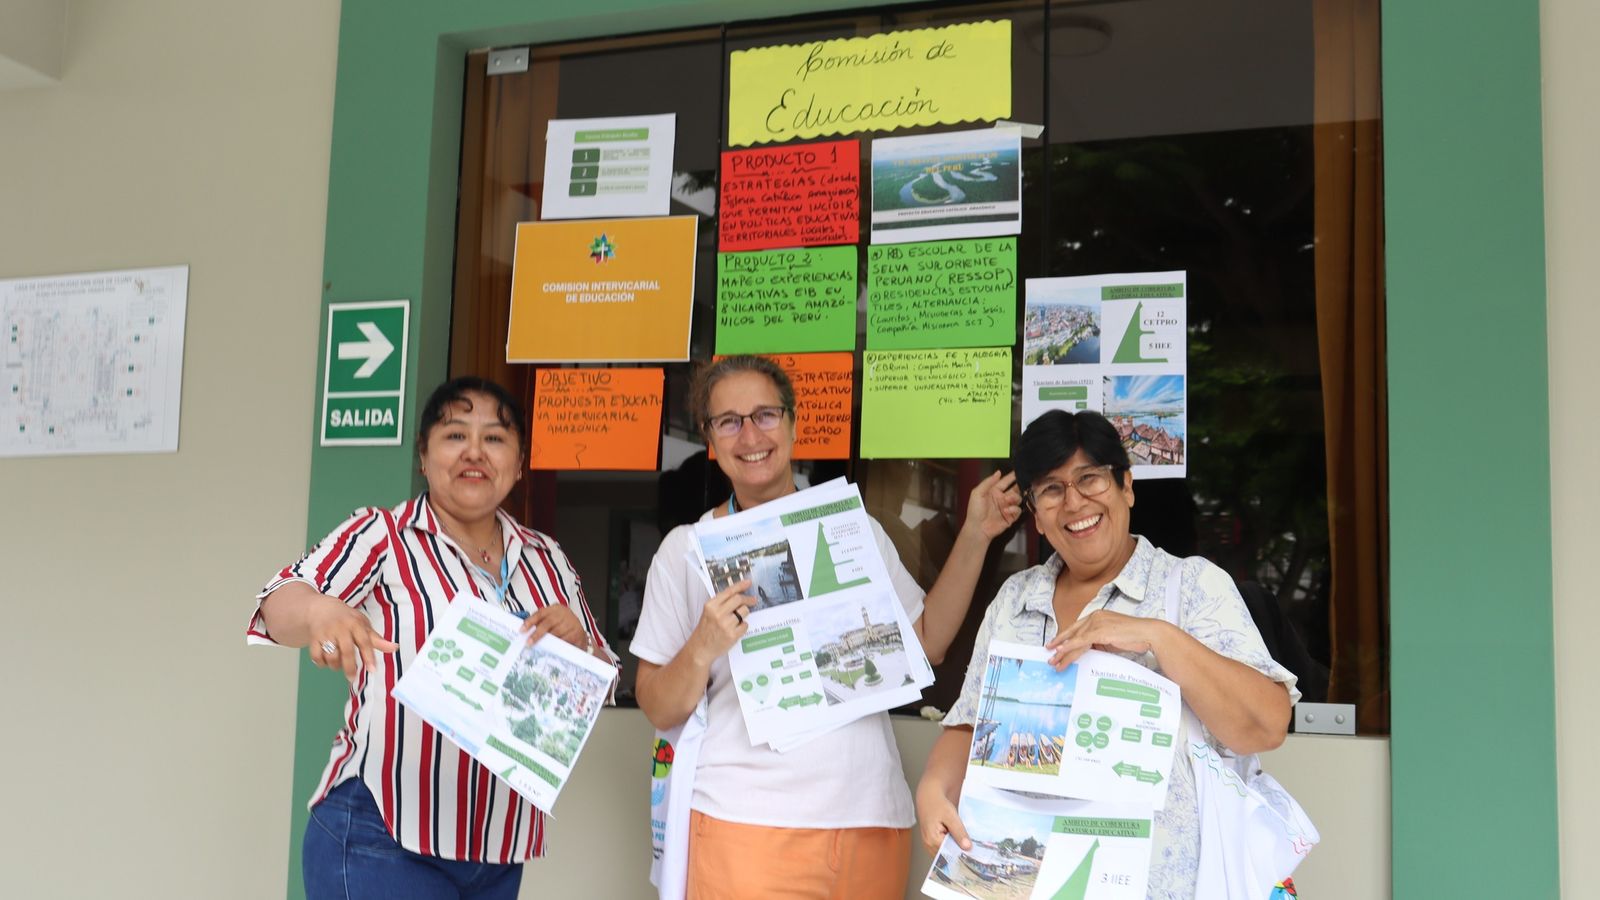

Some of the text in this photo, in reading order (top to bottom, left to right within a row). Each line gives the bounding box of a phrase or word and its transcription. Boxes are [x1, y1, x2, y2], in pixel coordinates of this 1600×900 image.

[796, 40, 957, 82] Comisión de
[766, 87, 940, 133] Educación
[583, 152, 588, 160] 1
[731, 144, 837, 172] PRODUCTO 1
[723, 175, 816, 192] ESTRATEGIAS
[746, 204, 803, 217] PERMITAN
[809, 199, 853, 213] INCIDIR
[721, 228, 797, 243] TERRITORIALES
[908, 244, 968, 259] ESCOLAR
[974, 242, 994, 254] DE
[999, 242, 1014, 253] LA
[724, 252, 796, 269] PRODUCTO
[872, 262, 909, 275] SELVA
[592, 280, 661, 291] INTERVICARIAL
[722, 269, 853, 289] MAPEO EXPERIENCIAS
[875, 274, 933, 288] PERUANO
[566, 293, 578, 303] DE
[721, 287, 789, 302] EDUCATIVAS
[794, 286, 818, 298] EIB
[883, 287, 955, 301] RESIDENCIAS
[731, 301, 796, 314] VICARIATOS
[967, 307, 978, 316] de
[720, 315, 756, 328] NICOS
[763, 314, 784, 326] DEL
[1143, 318, 1178, 326] CETPRO
[786, 356, 796, 368] 3
[878, 351, 939, 363] EXPERIENCIAS
[945, 350, 959, 359] FE
[541, 369, 612, 388] OBJETIVO
[876, 375, 909, 383] SUPERIOR
[874, 383, 909, 392] SUPERIOR
[538, 394, 606, 409] PROPUESTA
[796, 399, 843, 411] ATÓLICA
[330, 408, 394, 427] SALIDA
[537, 410, 639, 423] VA INTERVICARIAL
[1063, 827, 1096, 836] PASTORAL
[1091, 819, 1099, 829] DE
[1099, 819, 1141, 831] COBERTURA
[1101, 873, 1132, 886] 3 IIEE
